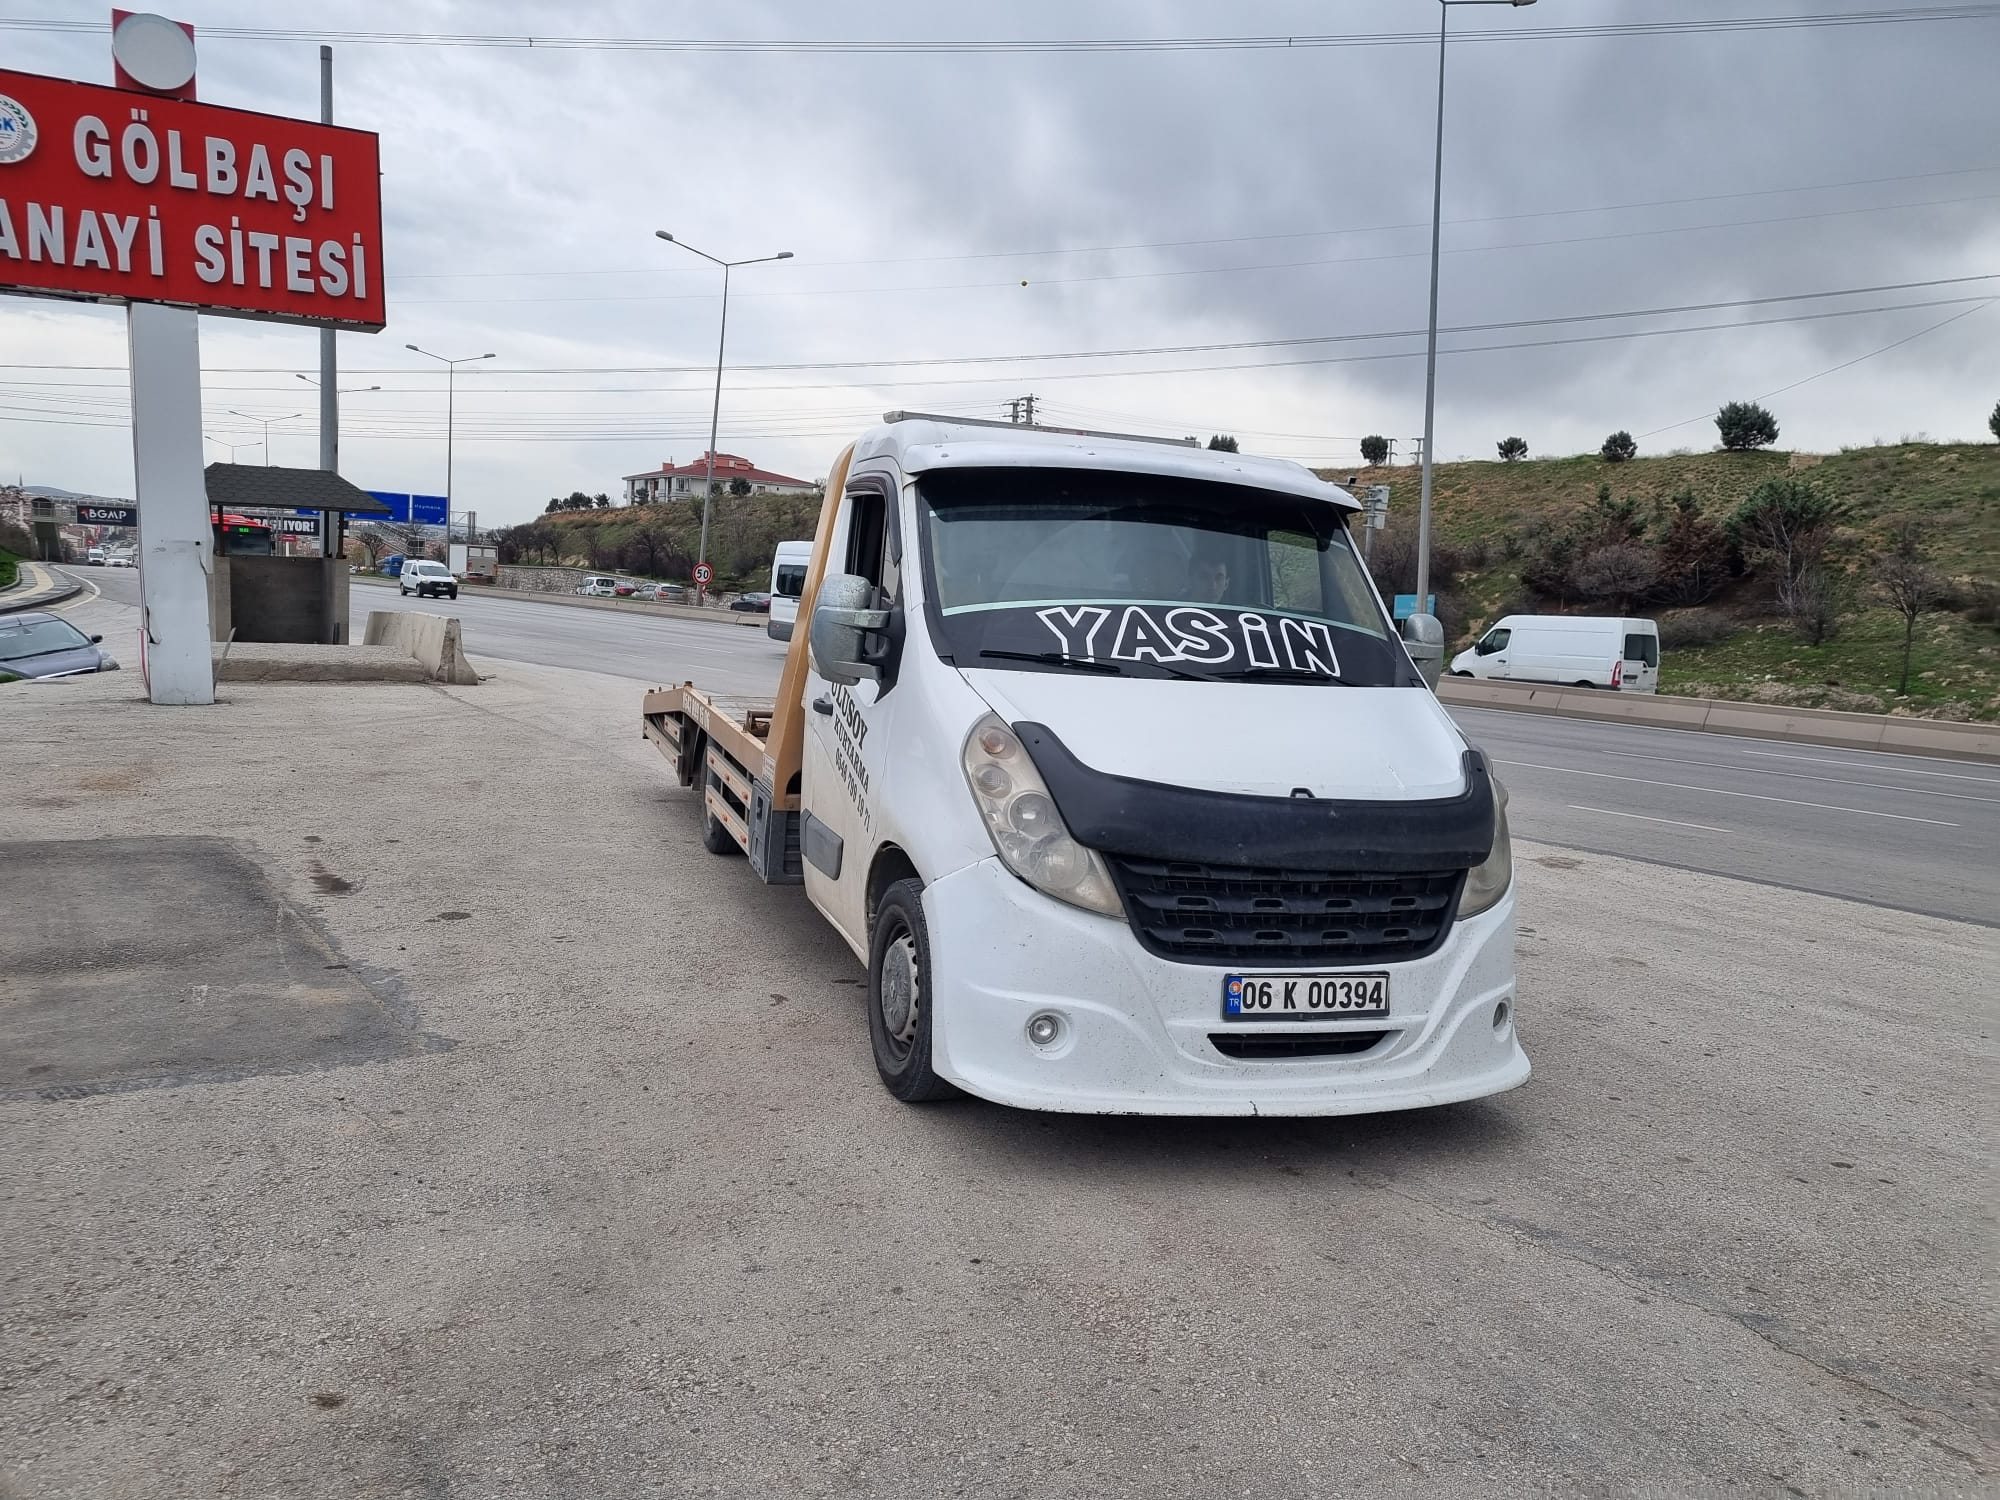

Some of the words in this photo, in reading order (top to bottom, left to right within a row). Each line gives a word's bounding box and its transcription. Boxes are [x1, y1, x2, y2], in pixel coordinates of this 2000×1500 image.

[73, 109, 334, 223] GÖLBAŞI
[194, 216, 366, 299] SİTESİ
[89, 508, 127, 519] BGMP
[697, 569, 709, 579] 50
[834, 713, 869, 794] KURTARMA
[1228, 998, 1240, 1007] TR
[1242, 981, 1272, 1010] 06
[1283, 982, 1298, 1009] K
[1308, 981, 1383, 1009] 00394
